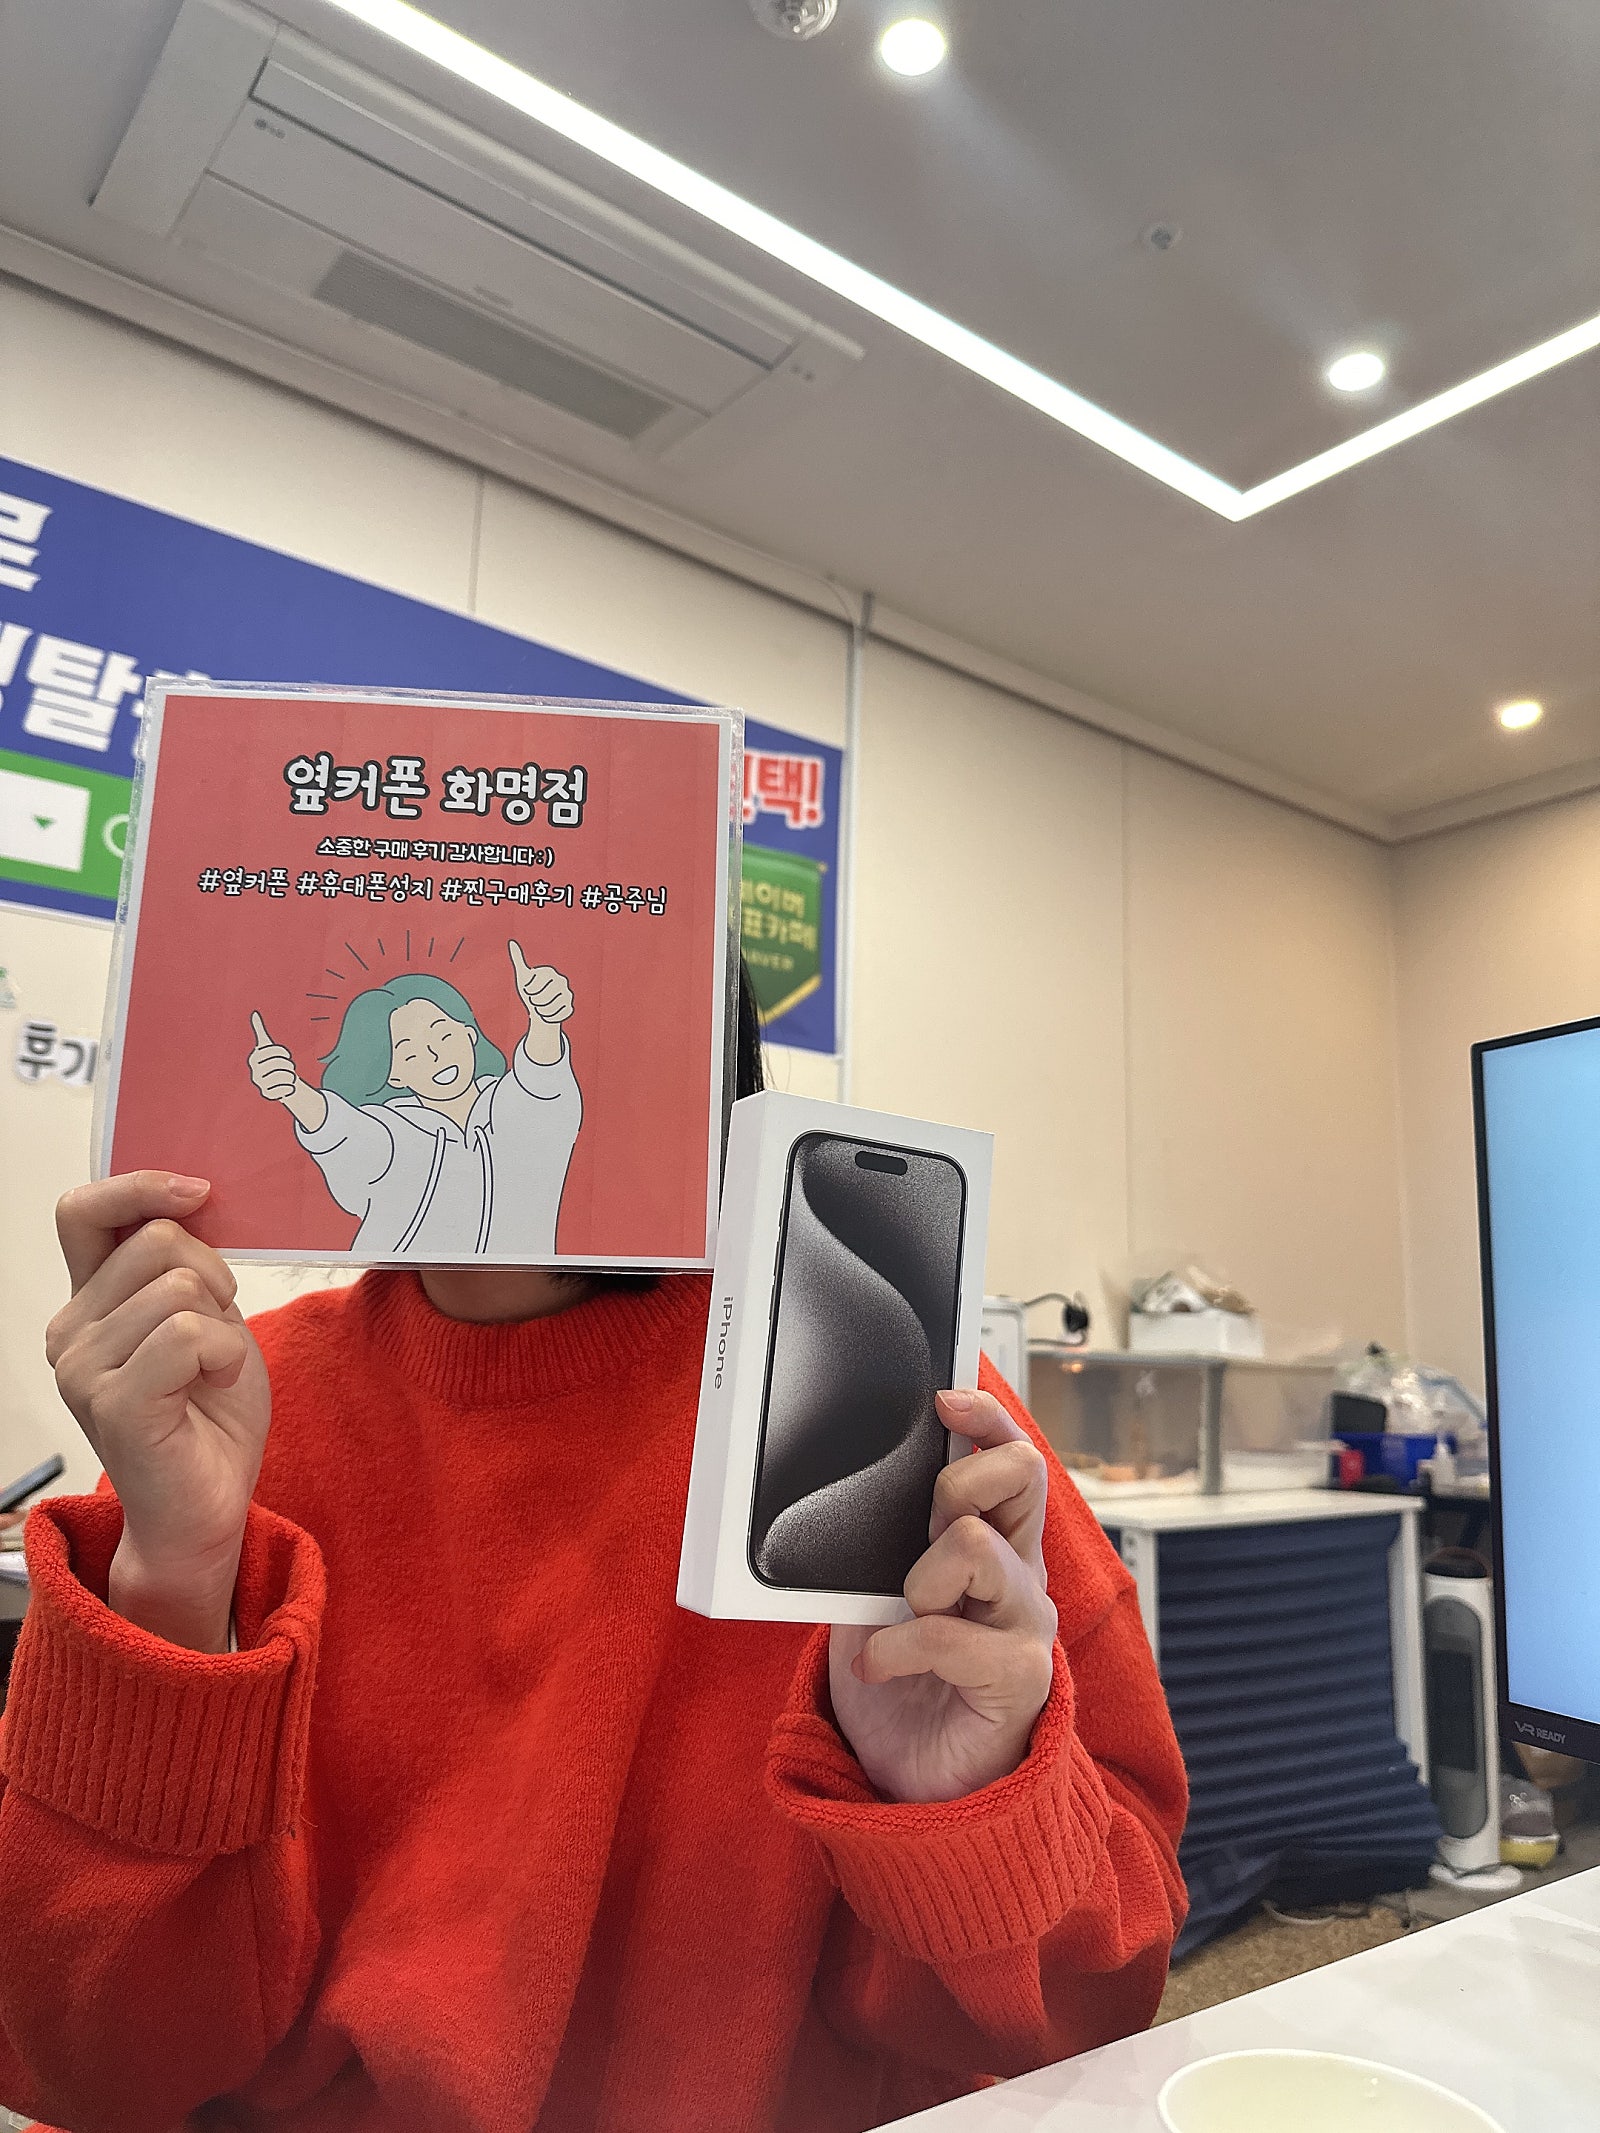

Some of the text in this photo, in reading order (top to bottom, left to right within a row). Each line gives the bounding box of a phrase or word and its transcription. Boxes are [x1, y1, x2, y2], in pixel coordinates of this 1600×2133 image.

[285, 752, 587, 827] 옆커폰 화명점
[741, 753, 822, 826] 택!
[316, 836, 372, 857] 소중한
[373, 838, 408, 860] 구매
[411, 840, 446, 862] 후기
[198, 867, 668, 916] #옆커폰 #휴대폰성지 #찐구매후기 #공주님
[18, 1022, 98, 1082] 후기
[713, 1295, 734, 1390] iPhone
[1514, 1720, 1566, 1744] VR READY
